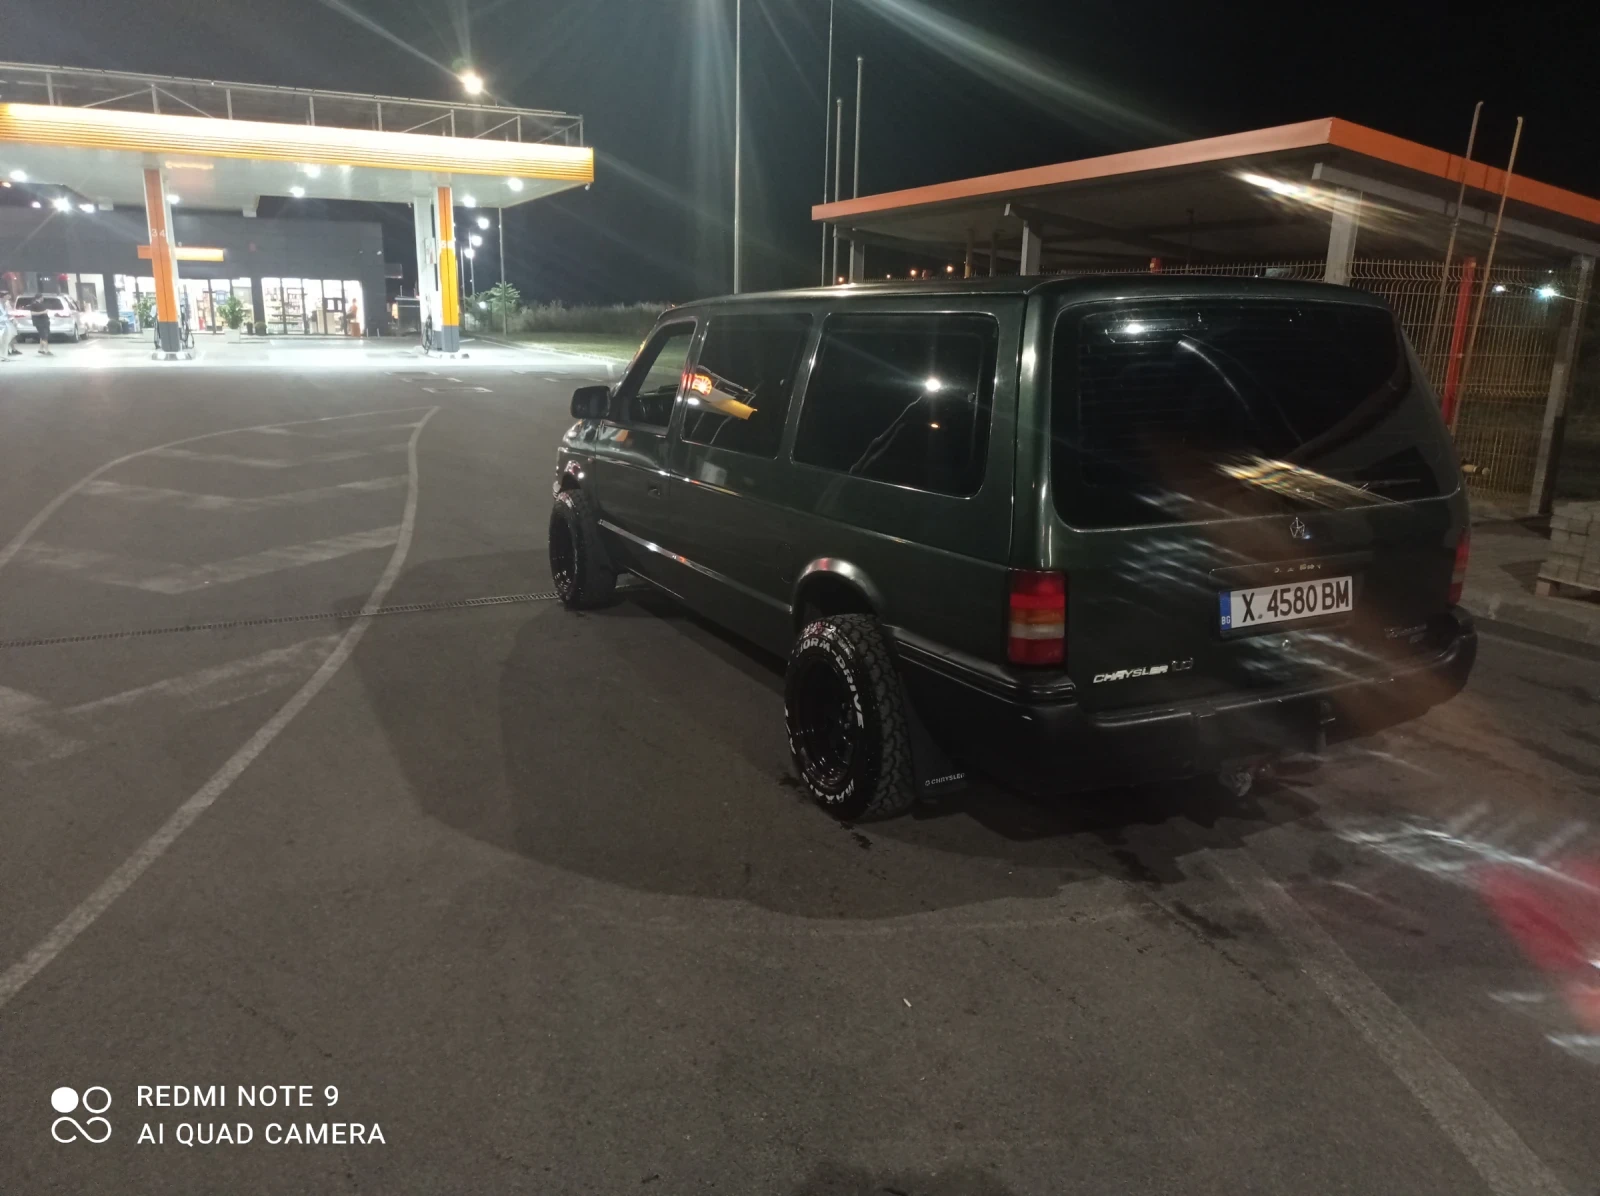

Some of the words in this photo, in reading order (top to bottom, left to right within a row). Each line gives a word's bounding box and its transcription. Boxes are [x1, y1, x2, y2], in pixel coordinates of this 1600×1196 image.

[1242, 592, 1255, 623] X
[1266, 584, 1318, 618] 4580
[1321, 580, 1349, 611] BM
[1221, 615, 1231, 625] BG
[1093, 664, 1169, 684] CHRYSLER
[930, 772, 966, 785] CHRYSLER
